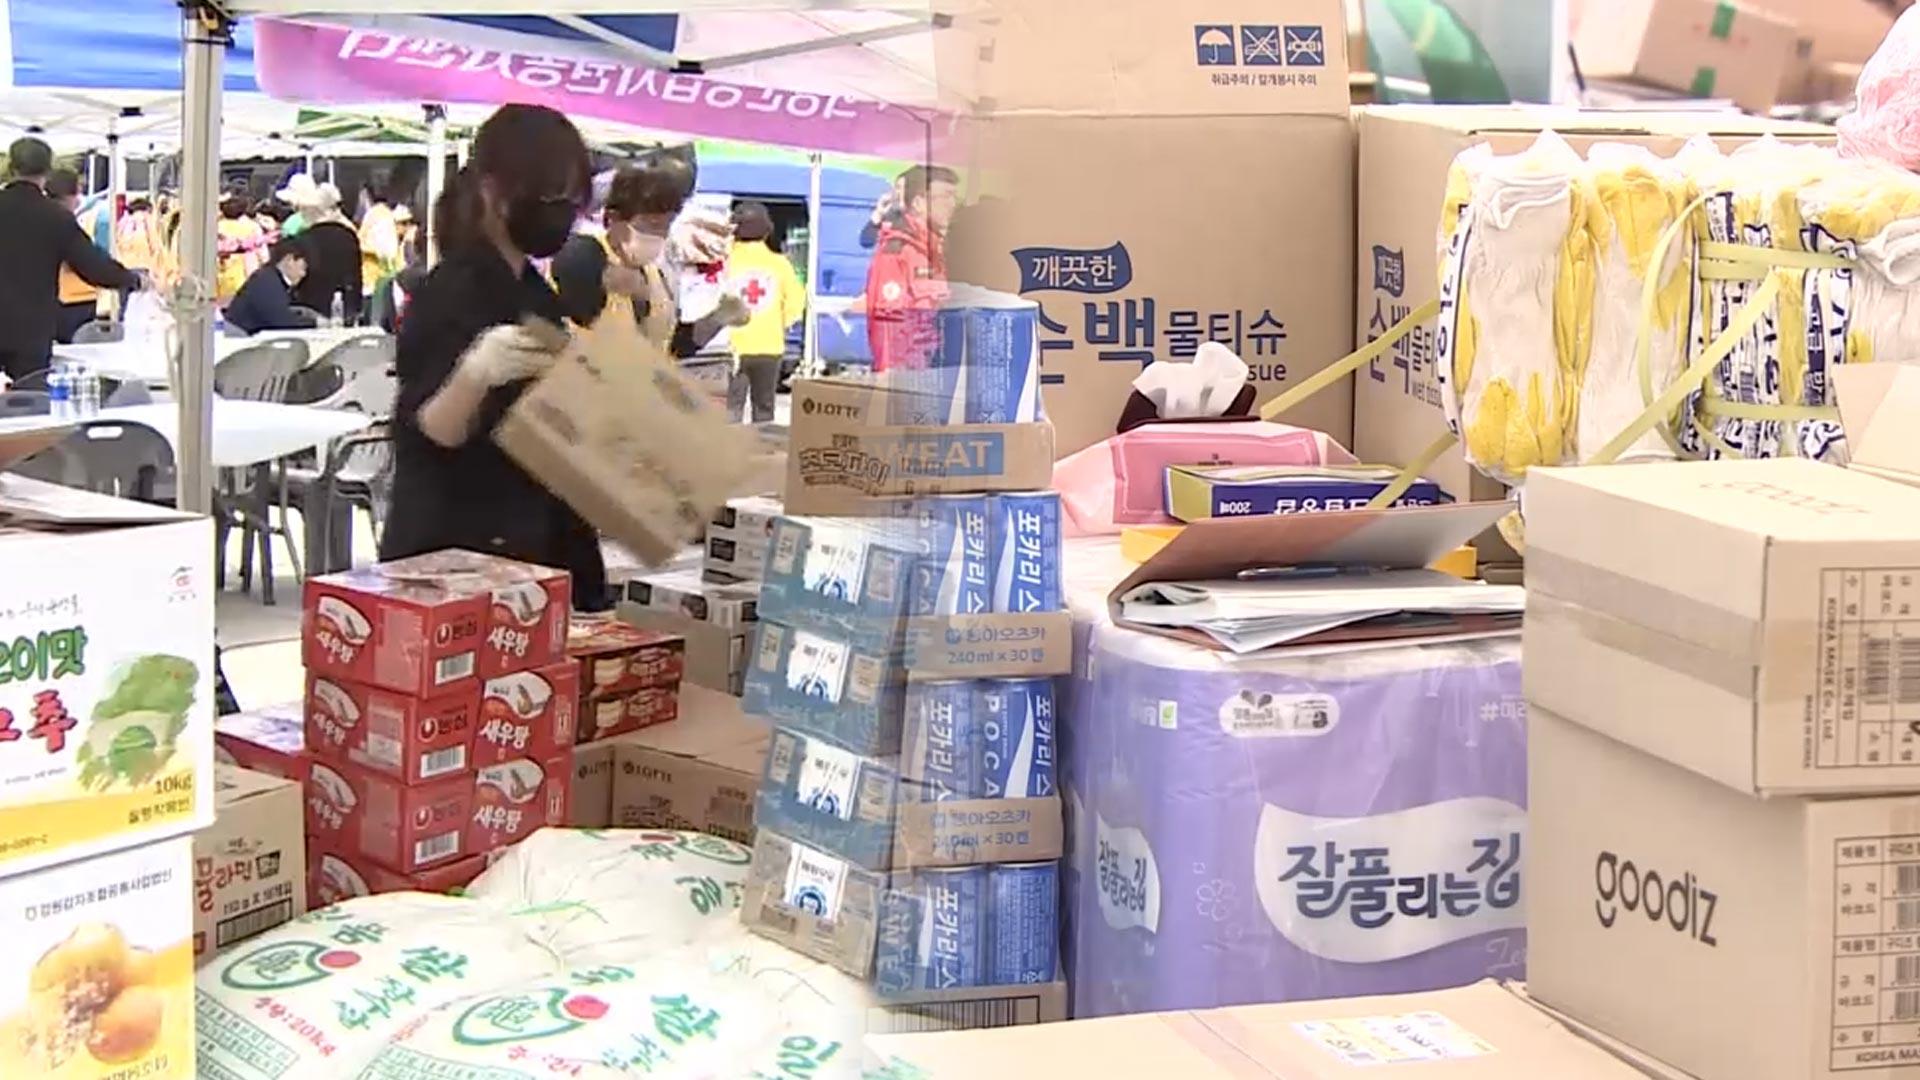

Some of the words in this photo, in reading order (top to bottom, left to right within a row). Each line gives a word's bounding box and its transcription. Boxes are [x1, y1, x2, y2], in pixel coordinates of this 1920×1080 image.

[1031, 255, 1117, 287] 깨끗한
[818, 402, 861, 419] LOTTE
[486, 627, 529, 656] 새우탕
[477, 719, 532, 750] 새우탕
[472, 805, 524, 835] 새우탕
[1277, 831, 1521, 929] 잘풀리는집
[1595, 851, 1718, 948] goodiz
[1855, 1050, 1897, 1064] KOREA
